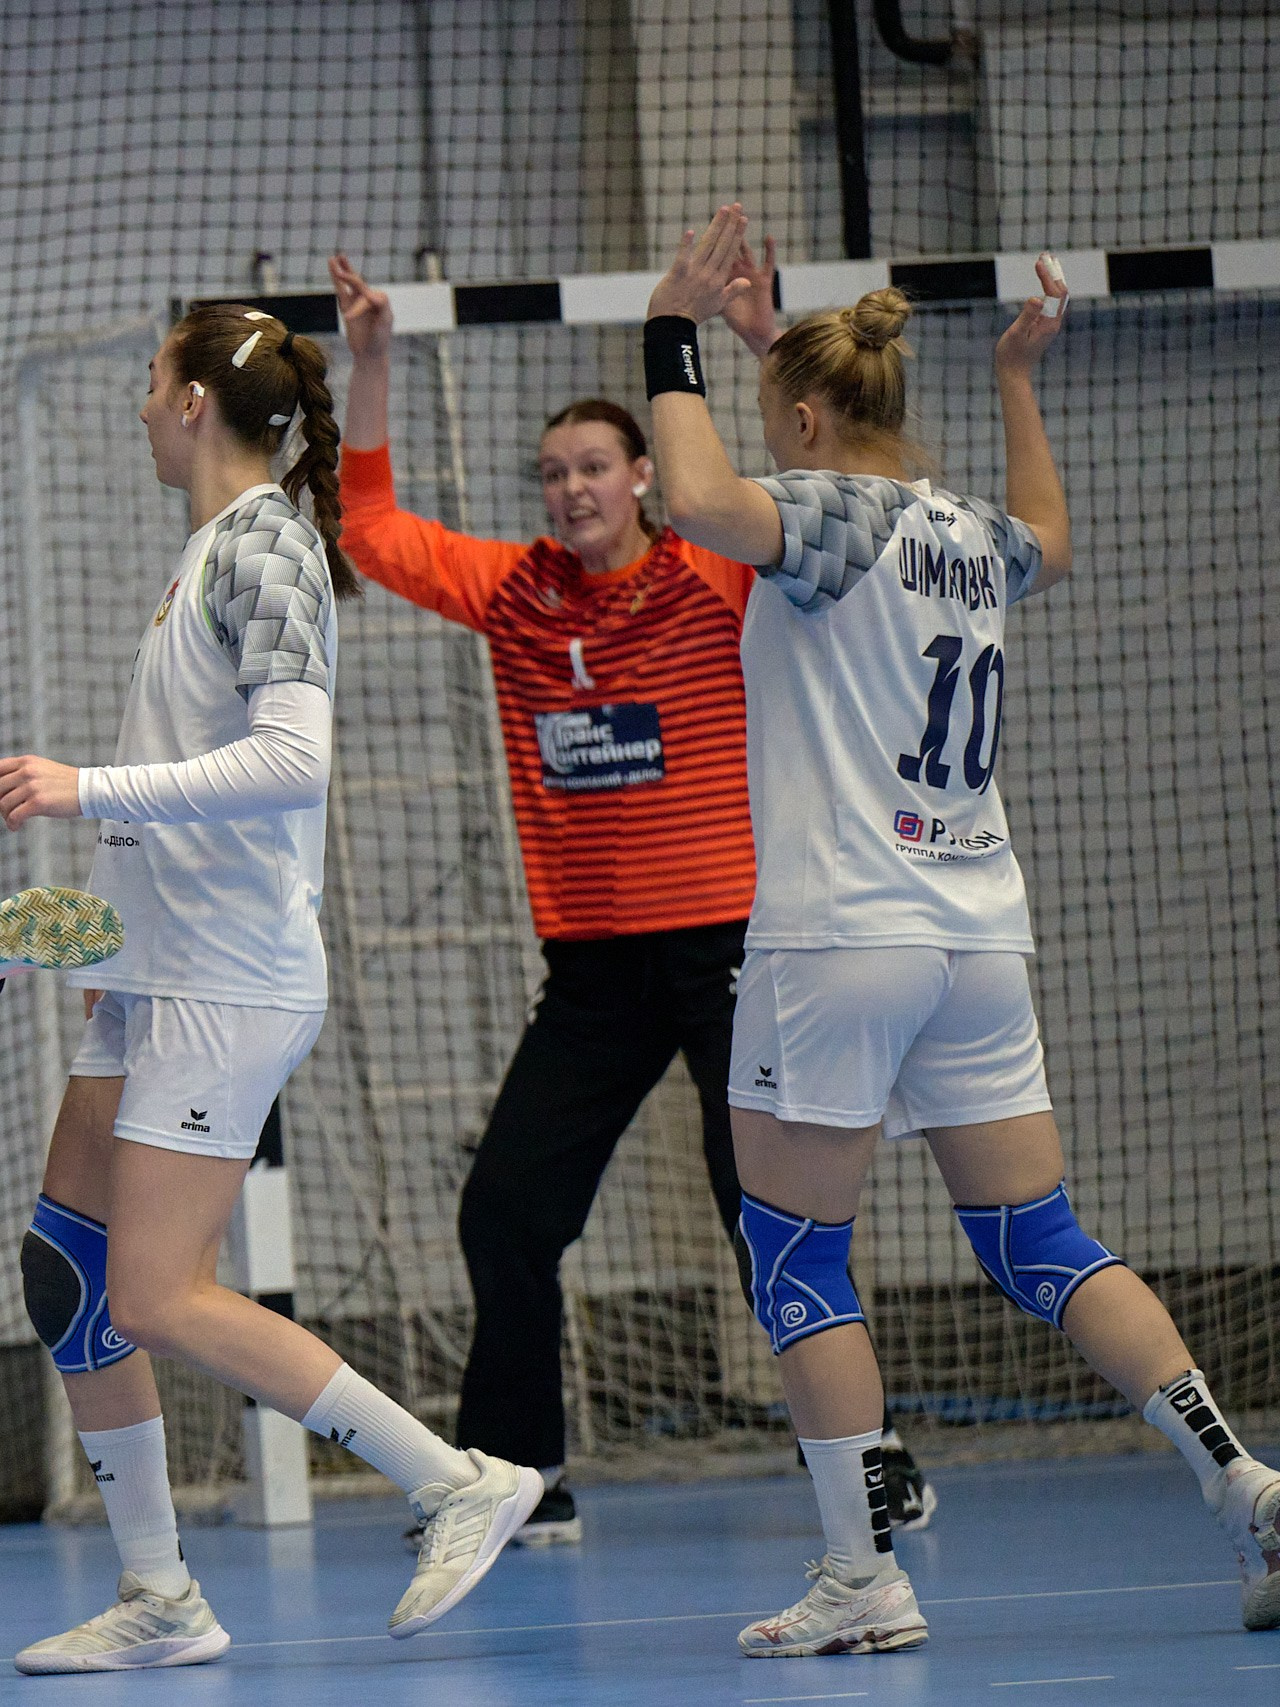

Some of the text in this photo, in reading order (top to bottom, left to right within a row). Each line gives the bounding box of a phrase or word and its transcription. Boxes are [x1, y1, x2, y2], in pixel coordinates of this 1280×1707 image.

[681, 344, 698, 385] Kempa
[569, 637, 596, 690] 1
[897, 634, 1004, 796] 10
[895, 843, 936, 860] ГРУППА
[754, 1078, 778, 1090] erima
[181, 1121, 211, 1133] erima
